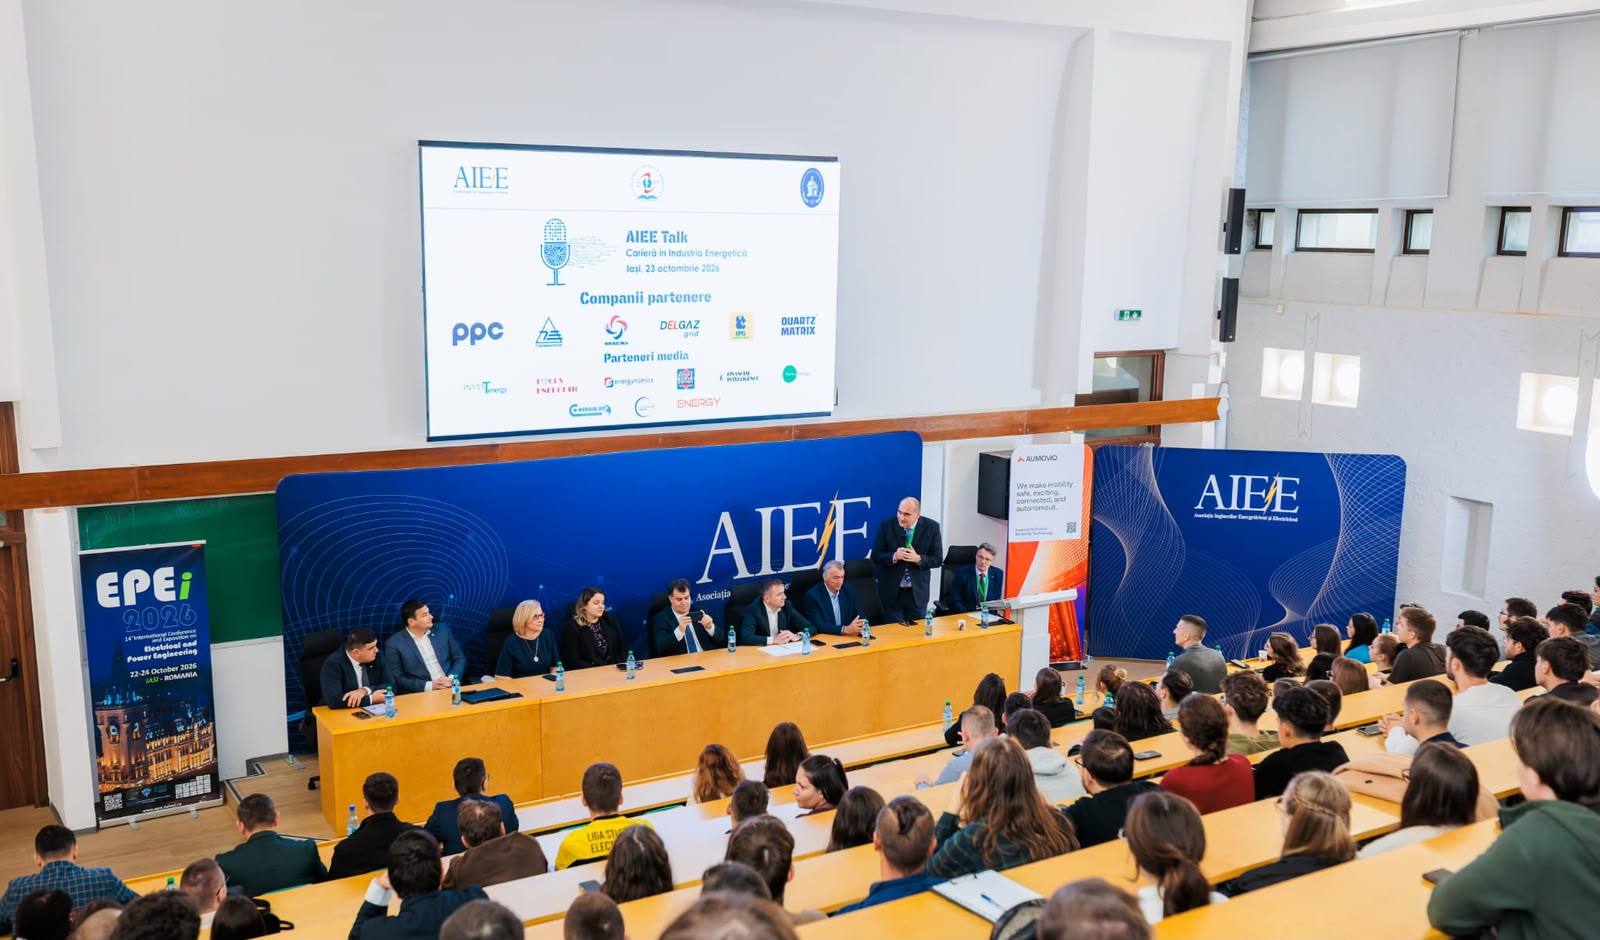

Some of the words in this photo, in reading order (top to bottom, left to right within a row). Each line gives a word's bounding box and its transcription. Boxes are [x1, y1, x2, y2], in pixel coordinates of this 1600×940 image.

[453, 166, 509, 189] AIEE
[625, 230, 658, 244] AIEE
[661, 230, 688, 244] Talk
[668, 248, 703, 258] Industria
[645, 264, 656, 273] 23
[657, 264, 700, 273] octombrie
[701, 264, 720, 273] 2026
[580, 291, 644, 306] Companii
[647, 292, 712, 305] partenere
[660, 319, 700, 330] DELGAZ
[781, 316, 816, 326] QUARTZ
[452, 321, 504, 346] ppc
[683, 330, 699, 339] grid
[781, 326, 816, 336] MATRIX
[603, 351, 654, 363] Parteneri
[657, 350, 689, 361] media
[677, 397, 721, 408] ENERGY
[1026, 454, 1058, 462] AUMOVIO
[1016, 482, 1028, 490] We
[1029, 481, 1047, 489] make
[1048, 481, 1074, 489] mobility
[1194, 473, 1300, 513] AIEE
[696, 496, 872, 584] AIEE
[96, 566, 193, 608] EPEi
[695, 589, 732, 602] Asociația
[122, 603, 197, 633] 2026
[133, 631, 168, 641] International
[167, 629, 197, 637] Conference
[144, 642, 181, 653] Electrical
[182, 639, 198, 647] and
[127, 654, 152, 663] Power
[152, 648, 198, 660] Engineering
[129, 669, 150, 678] 22-24
[151, 665, 179, 675] October
[179, 662, 198, 671] 2026
[164, 671, 198, 681] ROMANIA
[586, 831, 605, 842] LIGA
